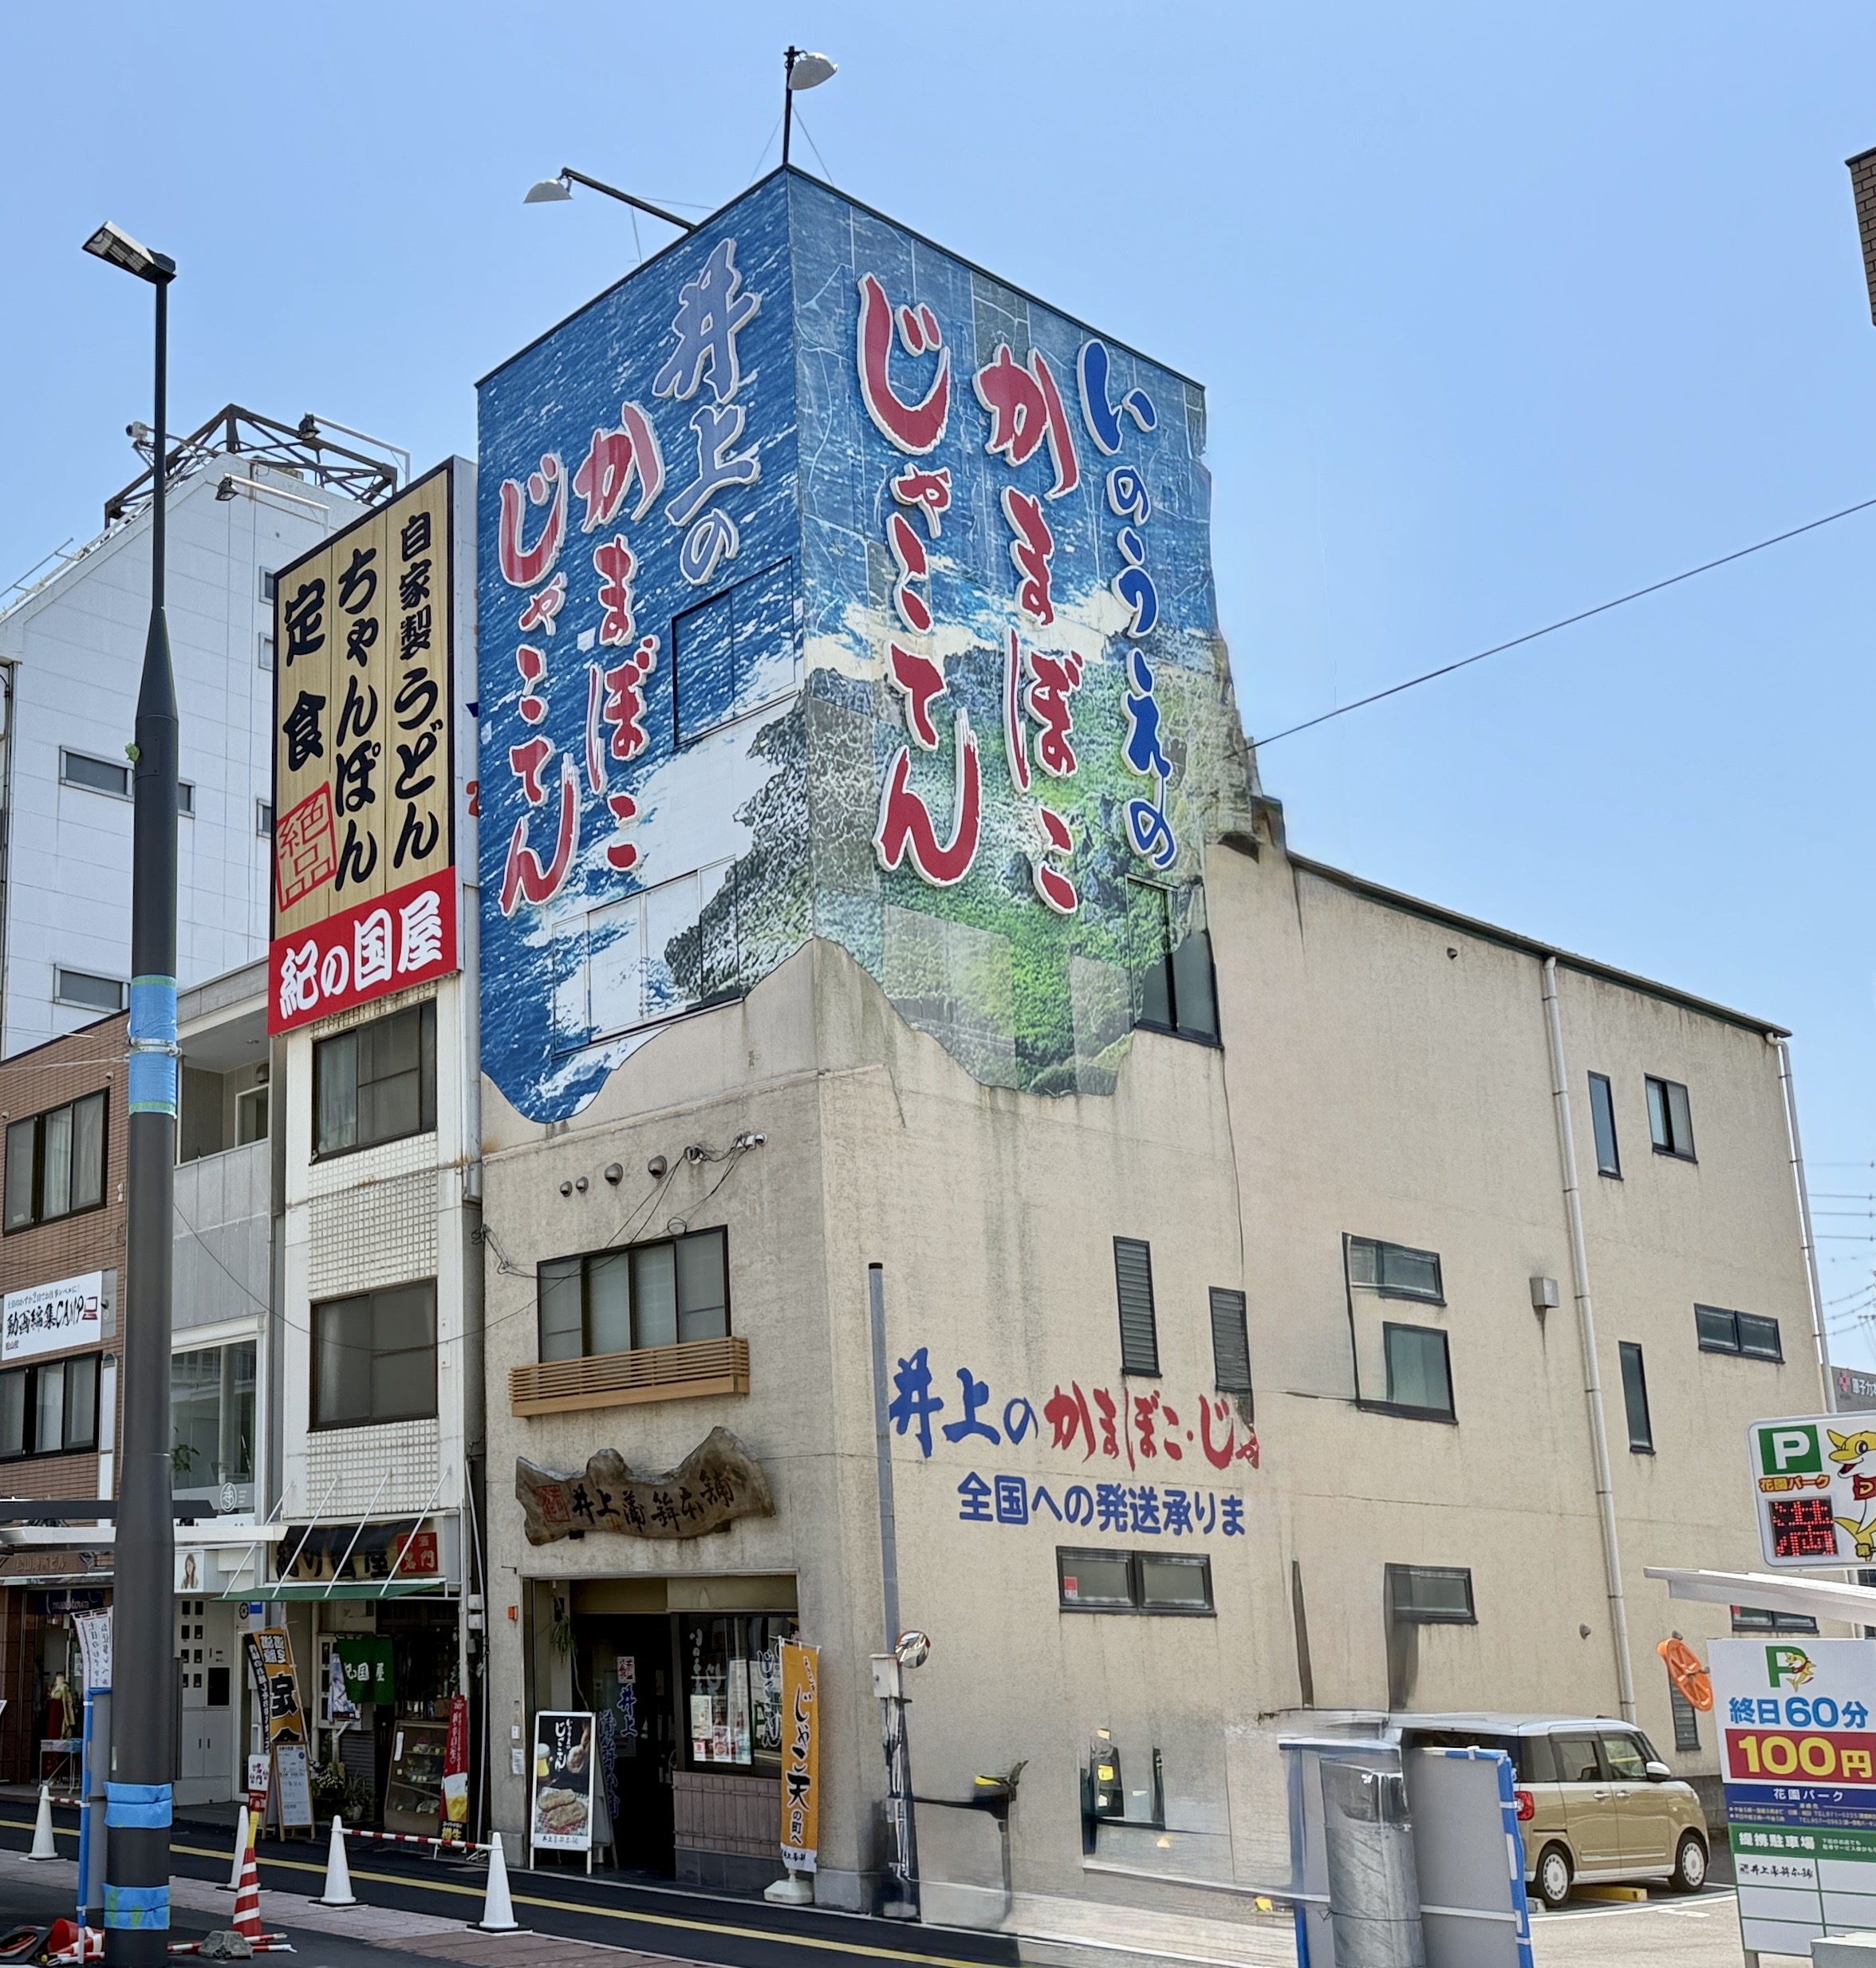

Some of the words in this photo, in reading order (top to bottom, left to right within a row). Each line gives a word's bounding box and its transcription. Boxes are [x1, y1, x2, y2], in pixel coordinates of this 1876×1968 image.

[654, 237, 761, 584] 井上の
[858, 272, 981, 885] じゃこてん
[1079, 339, 1176, 870] いのうえの
[282, 576, 327, 774] 定食
[571, 400, 662, 871] かまぼこ
[973, 343, 1083, 914] かまぼこ
[335, 546, 381, 893] ちゃんぽん
[395, 511, 439, 871] 自家製うどん
[496, 453, 578, 917] じゃこてん
[278, 889, 443, 1021] 紀の国屋
[6, 1295, 85, 1339] 動画編集CAMP
[1758, 1475, 1831, 1493] 花園パーク
[1772, 1430, 1811, 1470] P
[957, 1471, 1246, 1536] 全国への発送承りま
[1772, 1499, 1836, 1558] 満
[554, 1721, 567, 1772] じゃこてん
[617, 1683, 637, 1737] 井上
[1728, 1697, 1869, 1729] 終日60分
[1738, 1735, 1873, 1778] 100円
[786, 1683, 811, 1844] じゃこ天の町へ
[1773, 1787, 1843, 1802] 花園パーク
[1738, 1832, 1815, 1851] 提携駐車場
